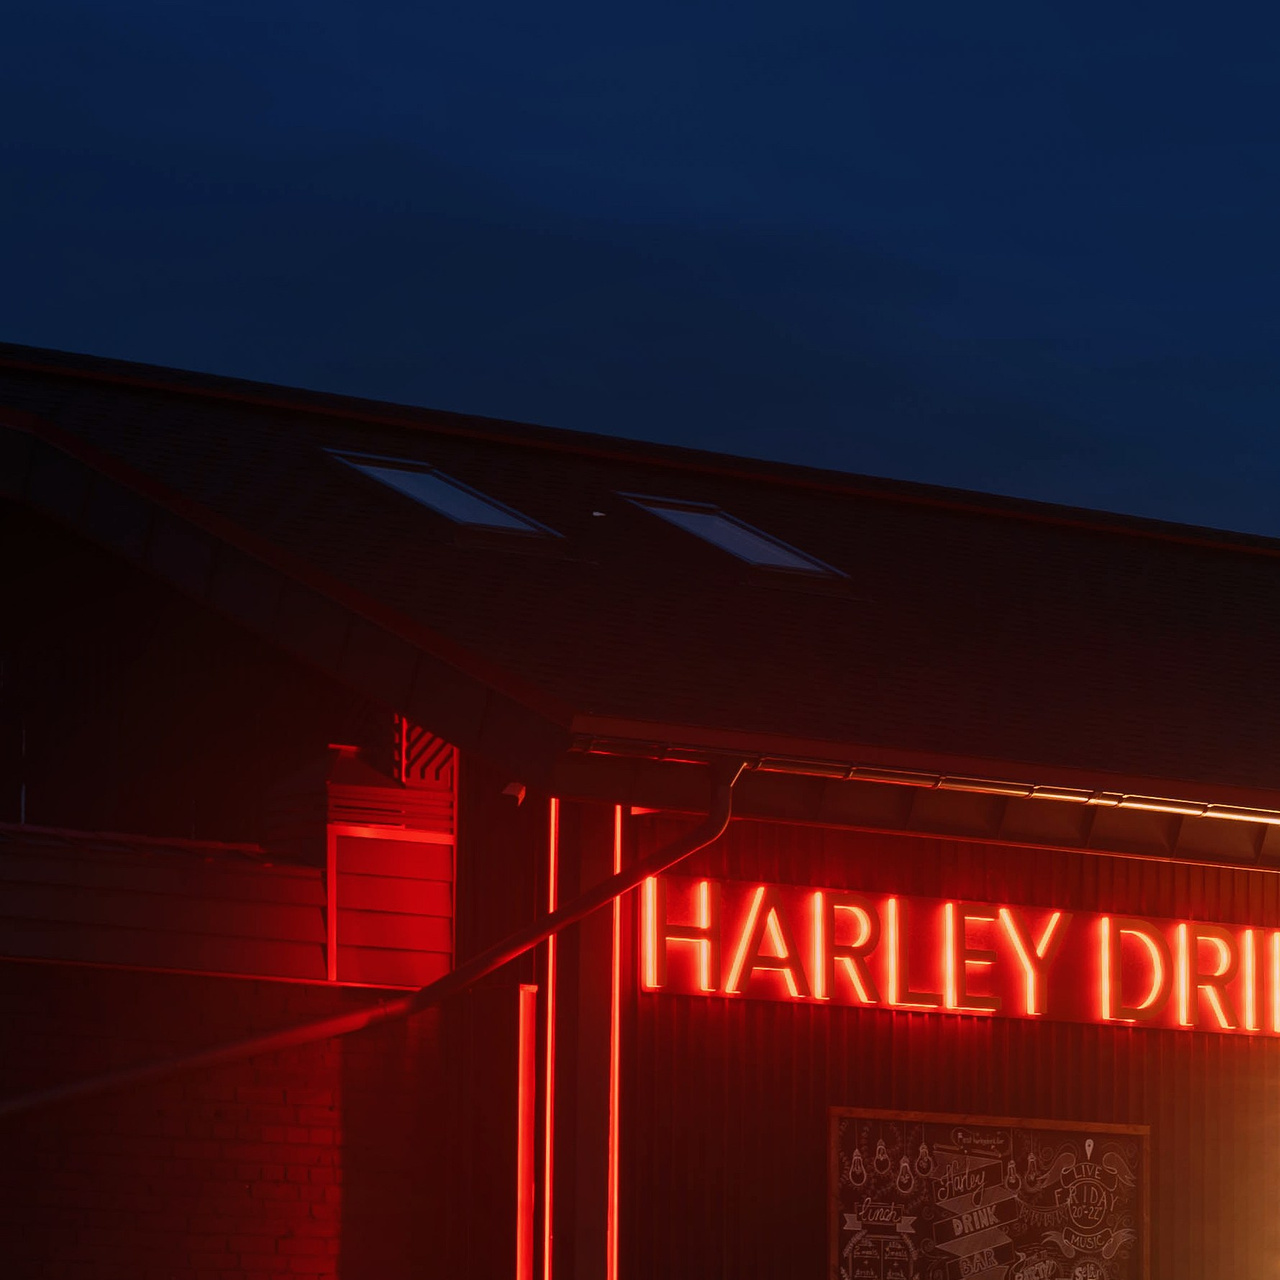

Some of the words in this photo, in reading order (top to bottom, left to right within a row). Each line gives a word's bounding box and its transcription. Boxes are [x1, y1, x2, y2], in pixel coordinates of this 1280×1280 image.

[641, 876, 1068, 1017] HARLEY
[937, 1156, 986, 1207] Harley
[1073, 1164, 1103, 1180] LIVE
[1054, 1185, 1119, 1212] FRIDAY
[952, 1204, 1000, 1237] DRINK
[1071, 1235, 1105, 1249] MUSIC
[959, 1248, 999, 1277] BAR
